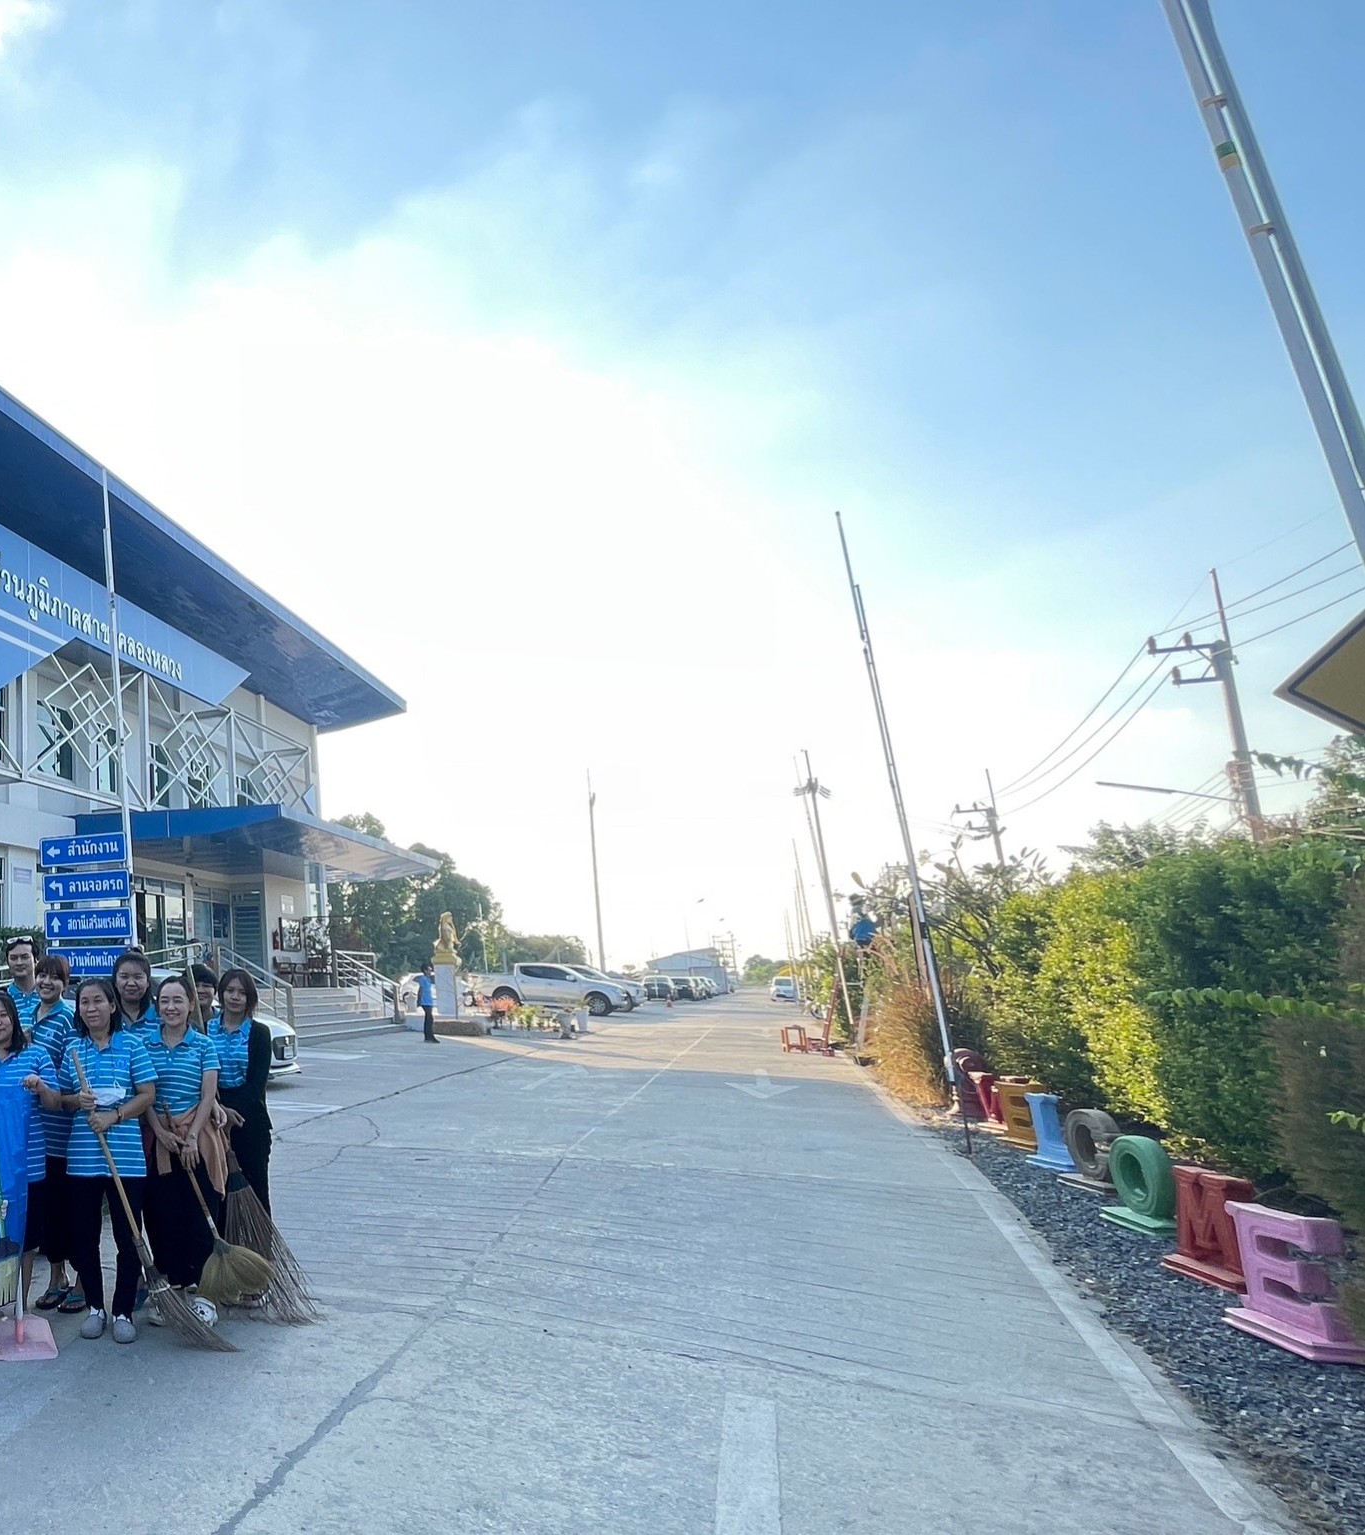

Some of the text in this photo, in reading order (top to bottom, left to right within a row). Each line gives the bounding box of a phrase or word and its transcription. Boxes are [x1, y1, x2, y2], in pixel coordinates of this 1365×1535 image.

[67, 839, 119, 857] สำนักงาน
[68, 878, 124, 893] ลานจอดรถ
[67, 912, 127, 931] สถานีเสริมแรงดัน
